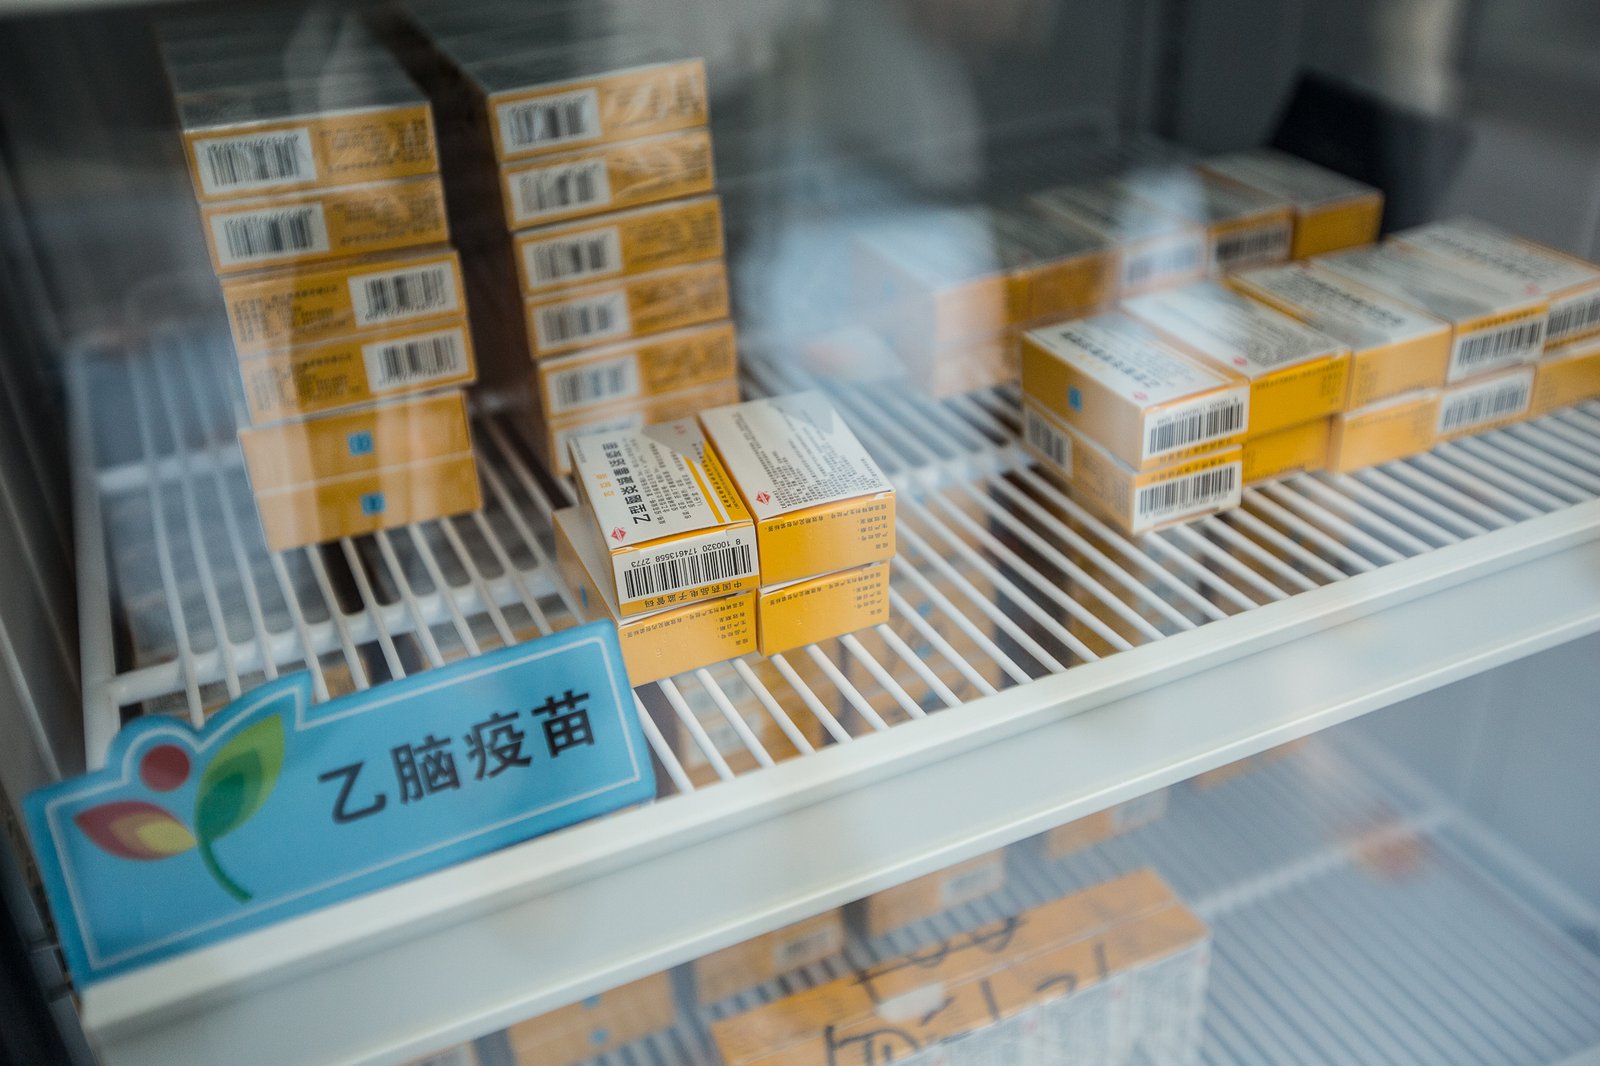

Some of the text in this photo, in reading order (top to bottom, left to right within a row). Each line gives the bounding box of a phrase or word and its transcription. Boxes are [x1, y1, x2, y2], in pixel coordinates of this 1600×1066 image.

[702, 541, 730, 552] 100320
[655, 548, 697, 562] 174613558
[630, 557, 650, 568] 2773
[645, 580, 742, 608] 中国药品电子监管码
[317, 689, 595, 825] 乙脑疫苗
